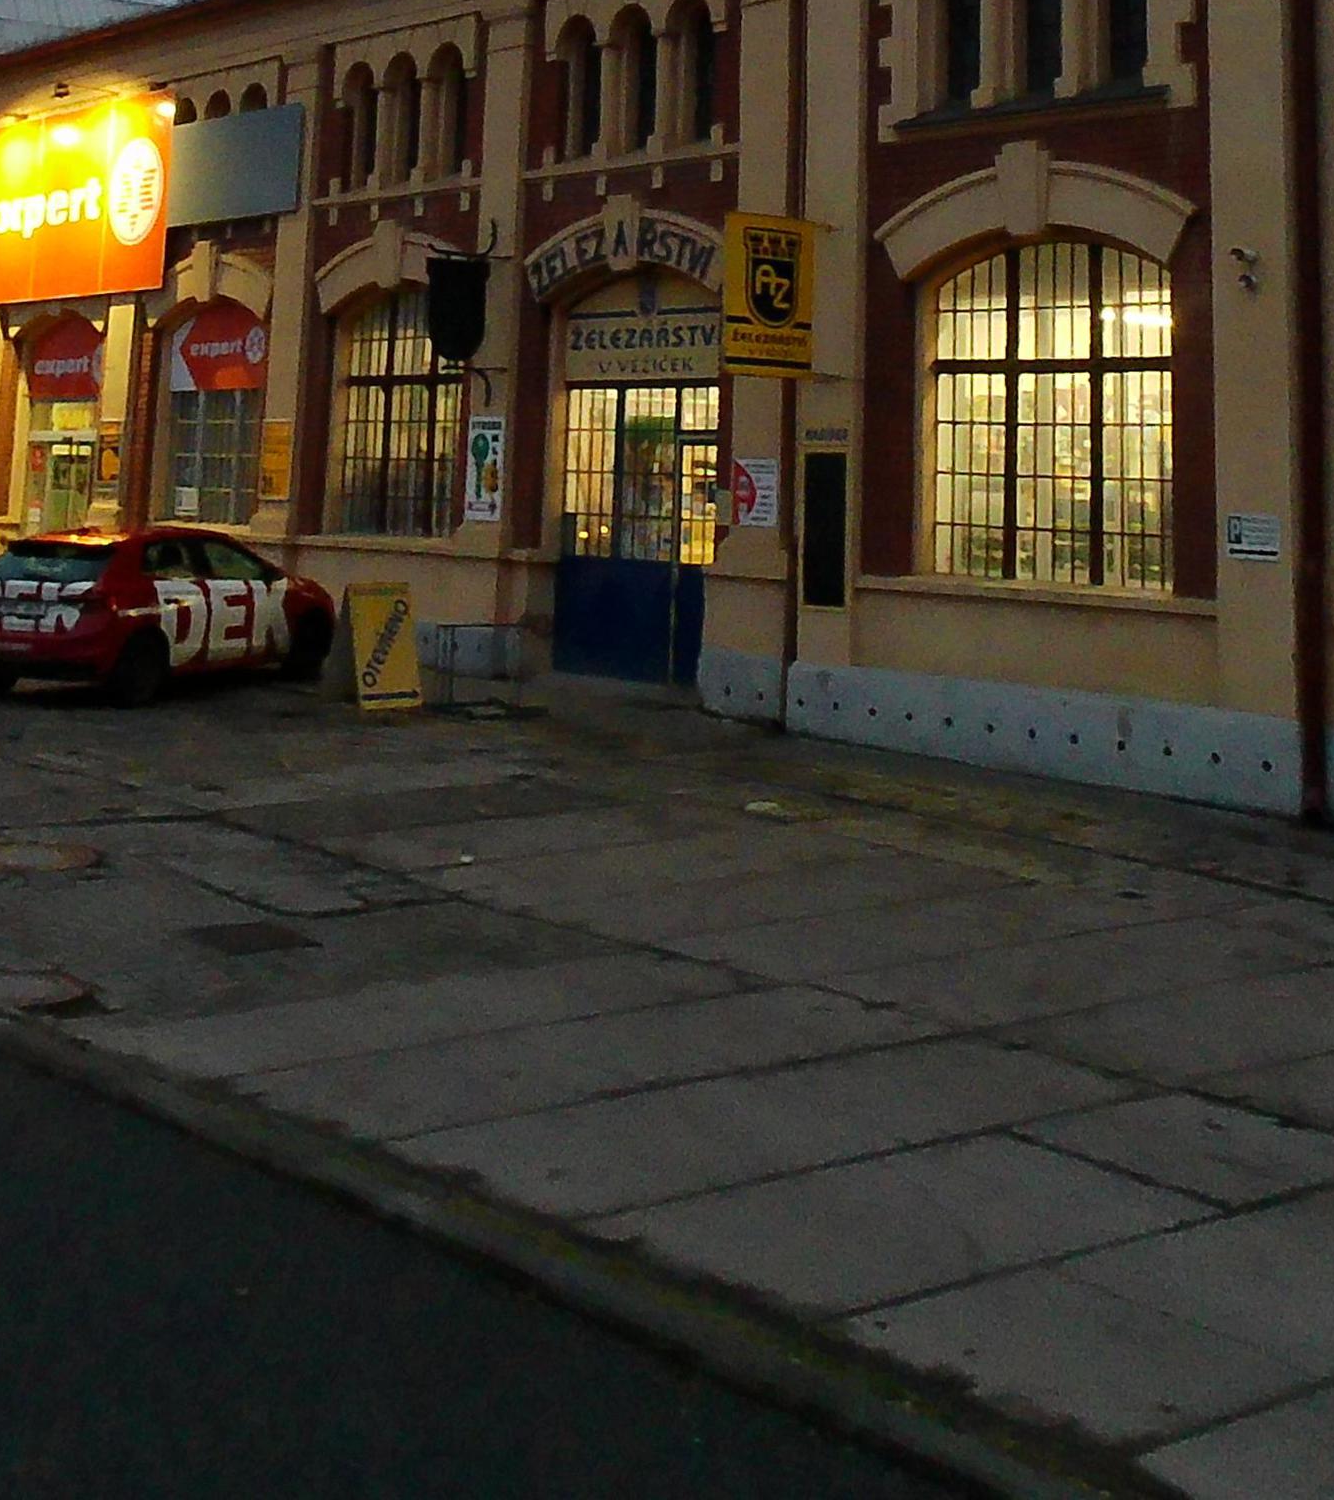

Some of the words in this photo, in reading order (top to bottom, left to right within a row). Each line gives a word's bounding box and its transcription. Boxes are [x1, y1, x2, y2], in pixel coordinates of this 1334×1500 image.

[755, 264, 791, 309] AZ
[190, 339, 243, 358] expert
[571, 320, 717, 350] ŽELEZÁŘSTV
[34, 354, 92, 377] expert
[153, 577, 291, 667] DEK
